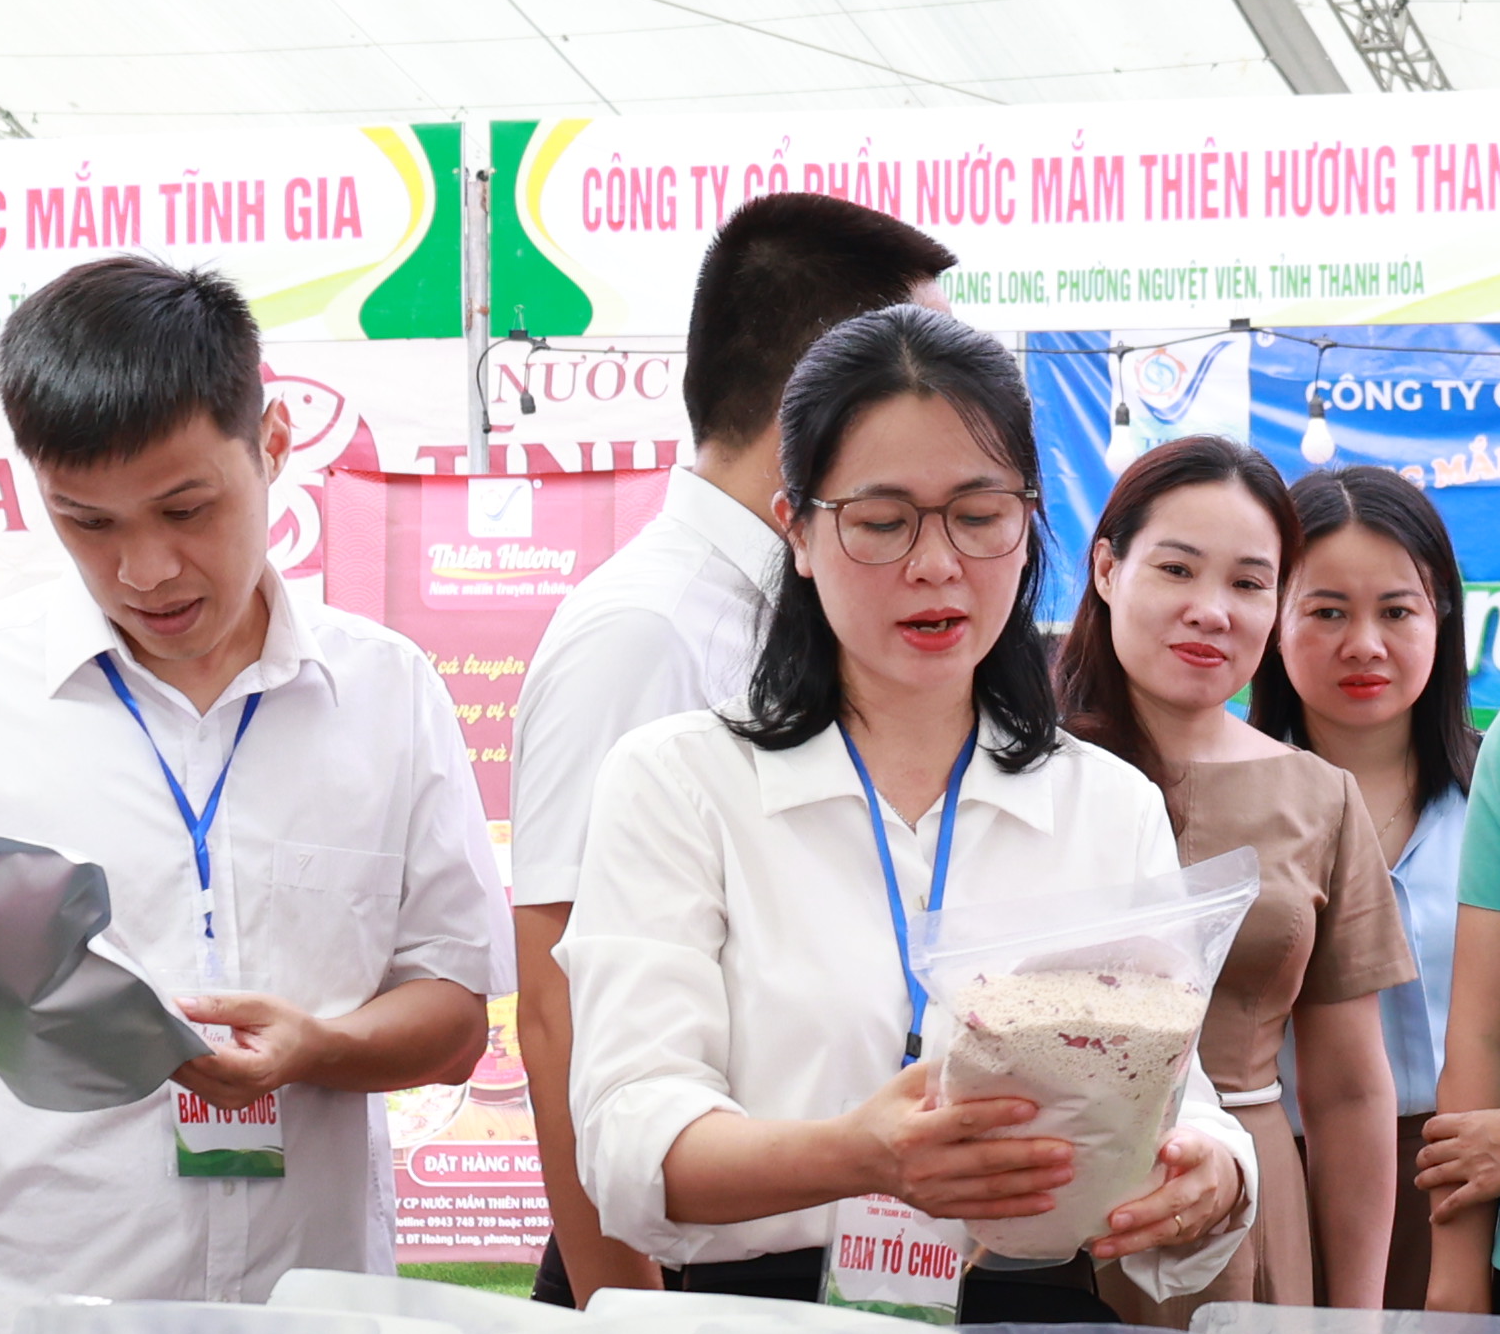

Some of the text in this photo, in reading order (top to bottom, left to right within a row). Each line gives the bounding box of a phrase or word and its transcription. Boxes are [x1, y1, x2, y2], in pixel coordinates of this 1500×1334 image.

[582, 152, 677, 232] CÔNG
[690, 165, 730, 231] TY
[916, 143, 1015, 226] NƯỚC
[1031, 129, 1125, 224] MẮM
[1139, 137, 1248, 221] THIÊN
[1265, 141, 1397, 217] HƯƠNG
[26, 161, 141, 250] MẮM
[159, 168, 265, 246] TĨNH
[284, 176, 363, 241] GIA
[938, 254, 1425, 309] OÀNG LONG, PHƯỜNG NGUYỆT VIÊN, TỈNH THANH HÓA
[491, 345, 670, 404] NƯỚC
[1305, 371, 1422, 412] CÔNG
[1432, 380, 1483, 411] TY
[428, 542, 577, 575] Thiên Hương
[481, 742, 507, 763] và
[424, 1151, 511, 1175] ĐẶT HÀNG
[403, 1198, 419, 1210] CP
[421, 1196, 453, 1210] NƯỚC
[455, 1193, 485, 1210] MẮM
[487, 1196, 520, 1210] THIÊN
[477, 1216, 497, 1228] 789
[838, 1228, 958, 1280] BAN TỔ CHỨC
